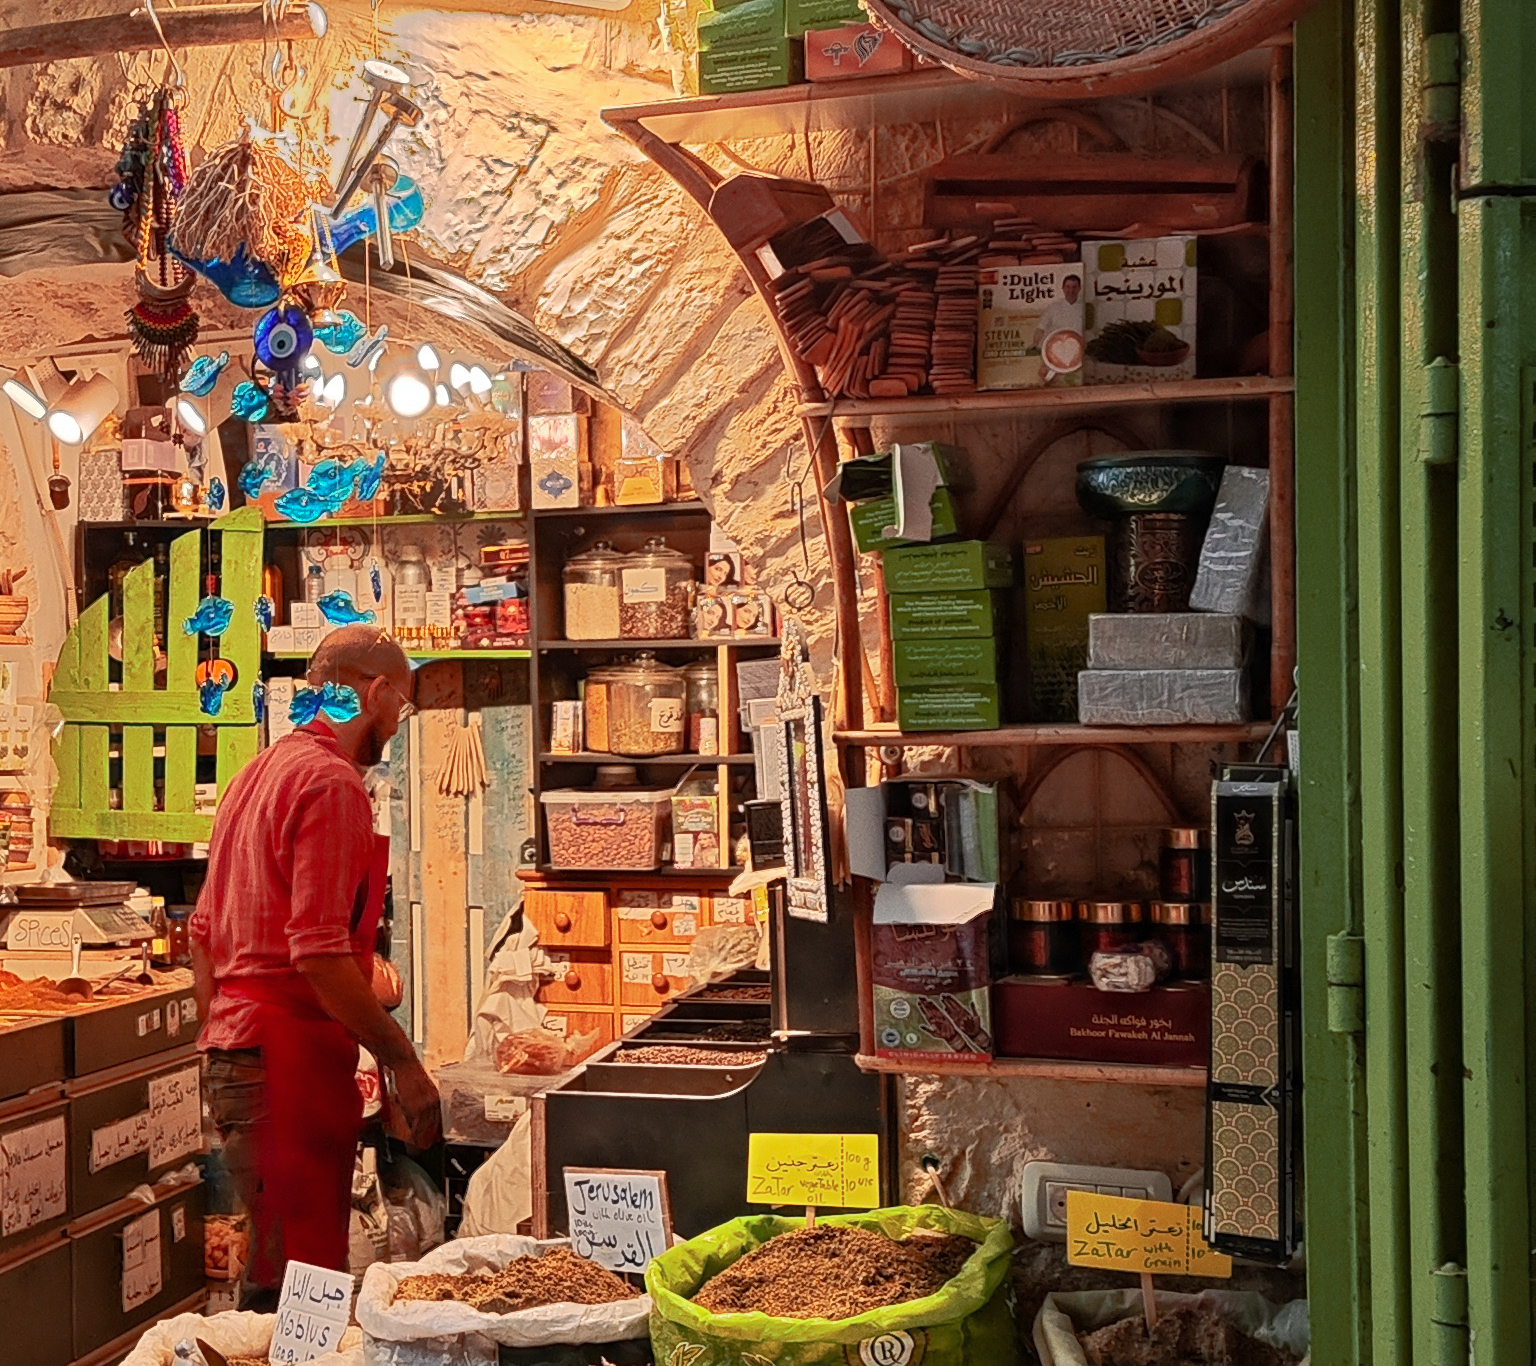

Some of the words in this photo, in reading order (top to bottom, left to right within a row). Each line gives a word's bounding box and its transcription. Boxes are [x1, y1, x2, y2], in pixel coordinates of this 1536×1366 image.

[1009, 287, 1055, 303] Light
[573, 1179, 653, 1215] Jerusalem
[276, 1310, 330, 1347] Nablus
